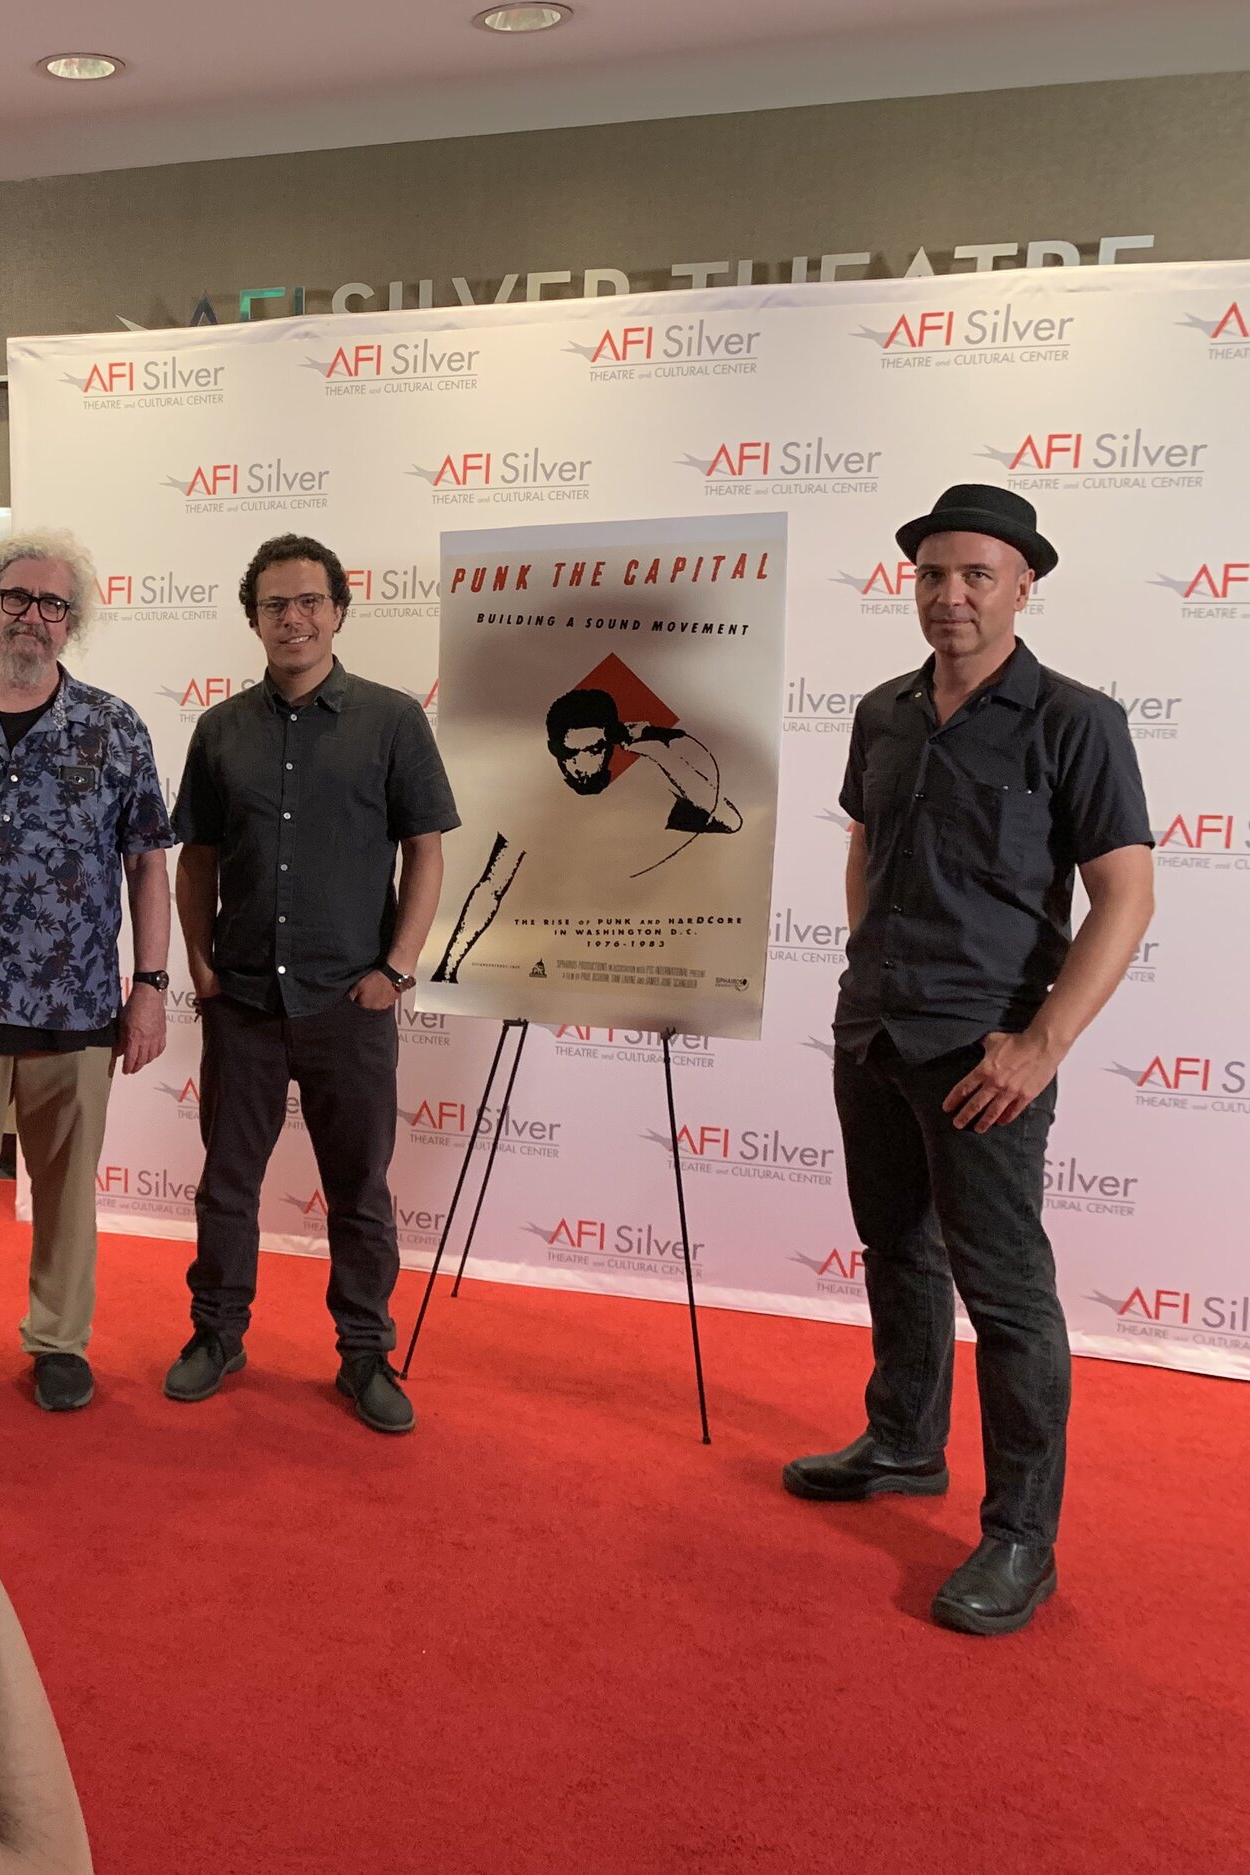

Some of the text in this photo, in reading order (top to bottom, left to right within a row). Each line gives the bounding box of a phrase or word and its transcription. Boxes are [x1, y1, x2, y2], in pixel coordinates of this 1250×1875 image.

[883, 304, 1074, 349] AFI Silver
[591, 319, 761, 363] AFI Silver
[326, 339, 481, 378] AFI Silver
[881, 356, 932, 369] THEATRE
[954, 352, 1016, 366] CULTURAL
[1019, 350, 1069, 363] CENTER
[1208, 348, 1250, 361] THEAT
[83, 357, 225, 393] AFI Silver
[589, 369, 635, 382] THEATRE
[655, 365, 710, 379] CULTURAL
[713, 363, 757, 376] CENTER
[325, 385, 366, 397] THEATRE
[384, 381, 434, 394] CULTURAL
[436, 379, 478, 391] CENTER
[83, 400, 122, 411] THEATRE
[138, 396, 184, 409] CULTURAL
[186, 394, 224, 406] CENTER
[706, 437, 882, 477] AFI Silver
[1008, 429, 1208, 470] AFI Silver
[186, 459, 330, 497] AFI Silver
[433, 448, 592, 487] AFI Silver
[432, 493, 475, 505] THEATRE
[492, 491, 545, 504] CULTURAL
[547, 489, 590, 502] CENTER
[704, 484, 751, 496] THEATRE
[771, 483, 829, 495] CULTURAL
[832, 481, 878, 493] CENTER
[1006, 478, 1060, 491] THEATRE
[1082, 478, 1149, 491] CULTURAL
[1152, 477, 1204, 489] CENTER
[185, 502, 225, 514] THEATRE
[240, 500, 288, 513] CULTURAL
[290, 498, 328, 510] CENTER
[347, 565, 440, 601] FI Silv
[451, 552, 770, 594] PUNK THE CAPITAL
[862, 561, 916, 596] AF
[1184, 564, 1250, 599] AF
[140, 572, 220, 605] Silver
[135, 611, 180, 622] CULTURAL
[181, 609, 218, 621] CENTER
[374, 607, 422, 618] CULTURAL
[860, 604, 910, 616] THEATRE
[1181, 608, 1237, 620] THEATRE
[477, 612, 750, 636] BUILDING A SOUND MOVEMENT
[180, 678, 231, 707] AFI
[788, 677, 861, 714] ilver
[783, 722, 853, 736] URAL CENTE
[1158, 814, 1234, 849] AFI
[1157, 856, 1211, 870] THEATRE
[514, 918, 536, 926] THE
[543, 918, 570, 926] RISE
[597, 918, 631, 926] PUNK
[575, 928, 663, 936] WASHINGTON
[670, 928, 698, 936] D.C.
[775, 908, 848, 946] ilver
[587, 940, 666, 948] 1976-1983
[770, 950, 846, 965] URAL CENTER
[398, 999, 447, 1029] lver
[411, 1036, 450, 1047] CENTER
[555, 1046, 599, 1059] THEATRE
[616, 1051, 663, 1064] CULTURA
[672, 1056, 714, 1068] CENTER
[1137, 1055, 1210, 1092] AFI
[1135, 1095, 1188, 1110] THEATRE
[1211, 1101, 1250, 1114] CULTU
[410, 1100, 561, 1141] AFI Slver
[410, 1134, 450, 1147] THEATRE
[520, 1146, 559, 1159] CENTER
[669, 1124, 834, 1168] AFI Silver
[137, 1169, 198, 1201] Silve
[668, 1160, 712, 1175] TEATRE
[731, 1167, 785, 1182] CULTURAL
[789, 1172, 832, 1186] CENTER
[131, 1202, 174, 1215] CULTURAL
[176, 1206, 198, 1217] CEN
[393, 1195, 445, 1231] lver
[1086, 1202, 1135, 1217] CENTER
[404, 1233, 441, 1247] CENTE
[549, 1217, 605, 1250] AFI
[547, 1252, 589, 1266] THEATRE
[607, 1259, 658, 1273] CULTURAL
[661, 1264, 703, 1278] CENR
[818, 1248, 865, 1279] AF
[817, 1282, 864, 1296] THEATRE
[1118, 1286, 1250, 1332] AFI Sil
[1117, 1323, 1168, 1340] THEATRE
[1192, 1335, 1250, 1351] CULTURA
